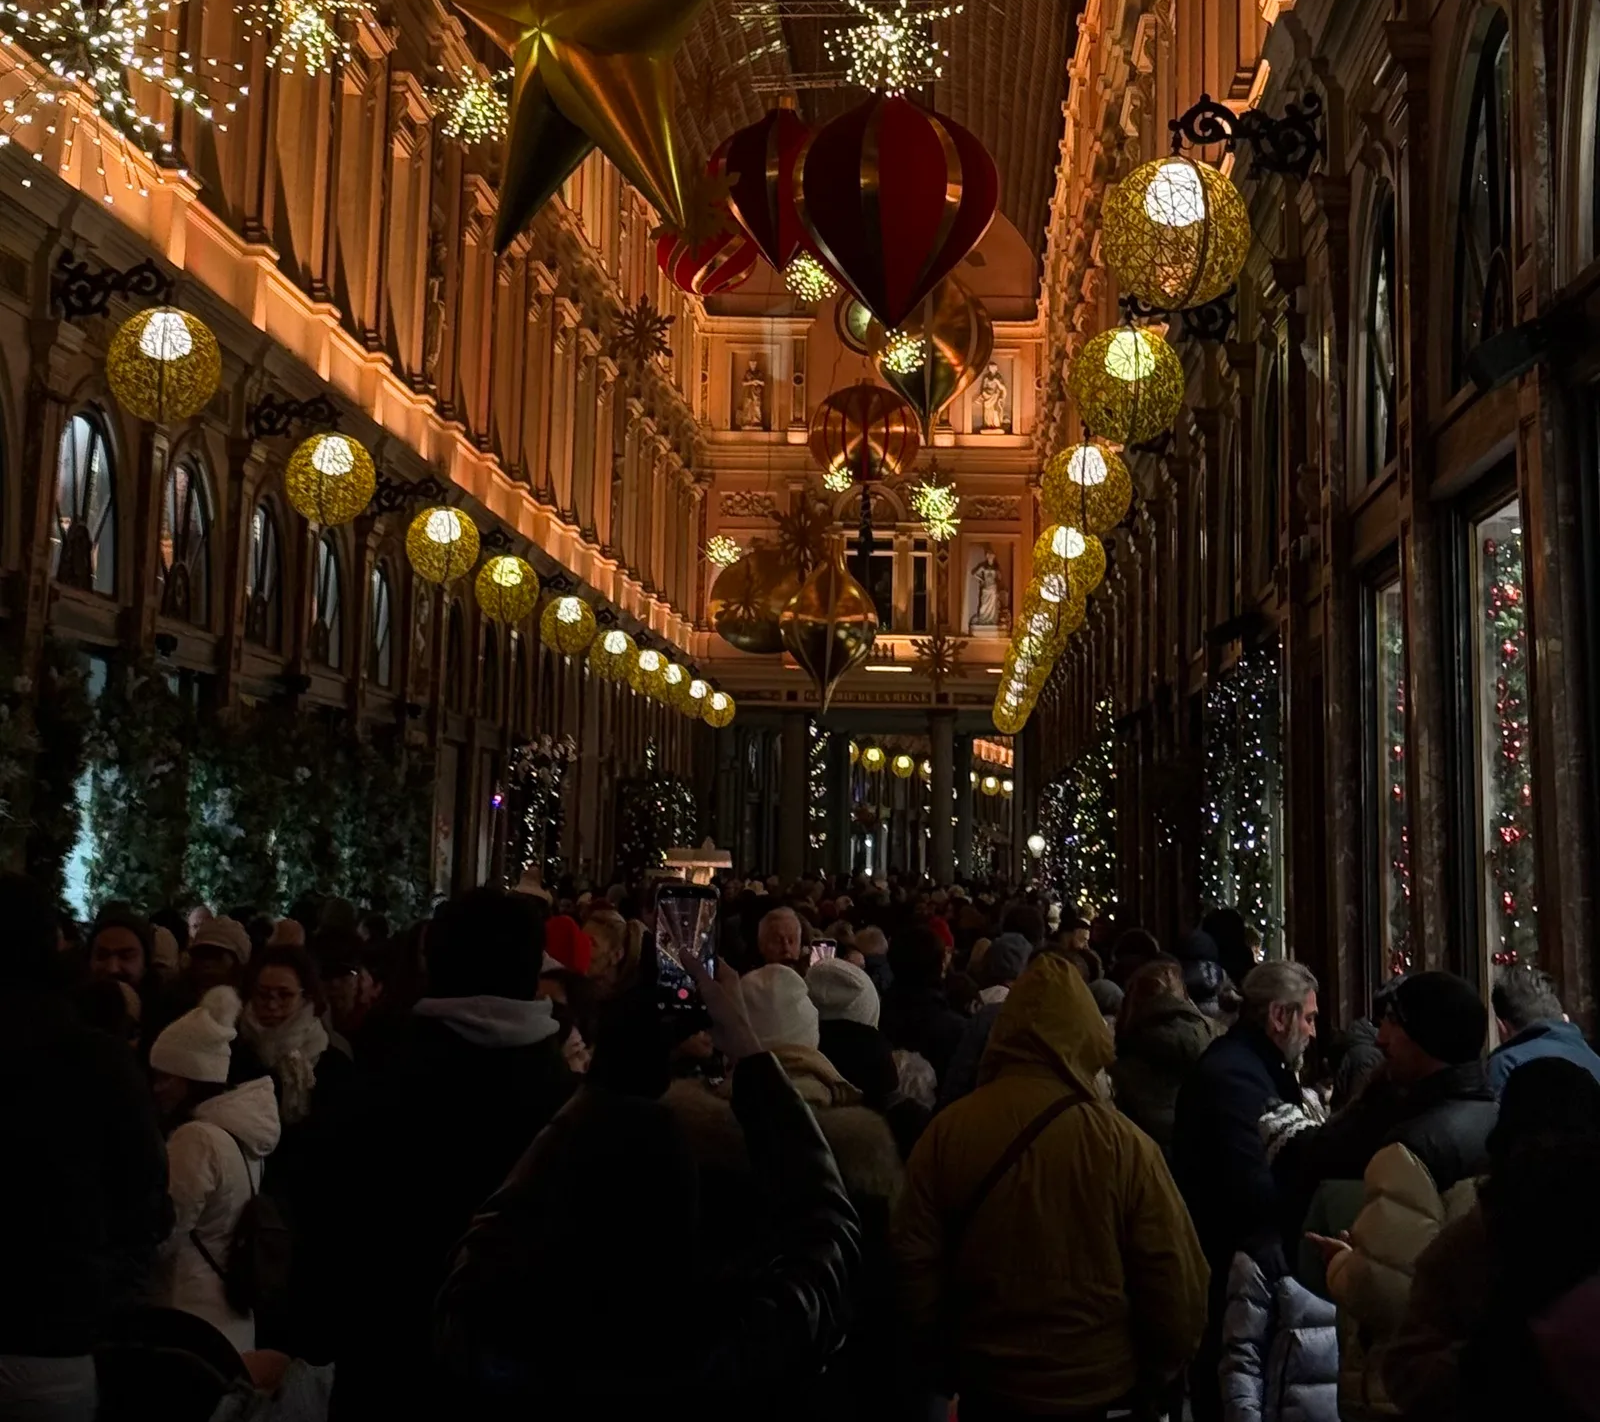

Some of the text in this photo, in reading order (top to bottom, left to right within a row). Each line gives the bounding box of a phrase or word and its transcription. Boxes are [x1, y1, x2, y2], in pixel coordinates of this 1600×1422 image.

[805, 692, 929, 702] GRIE DE LA REINE
